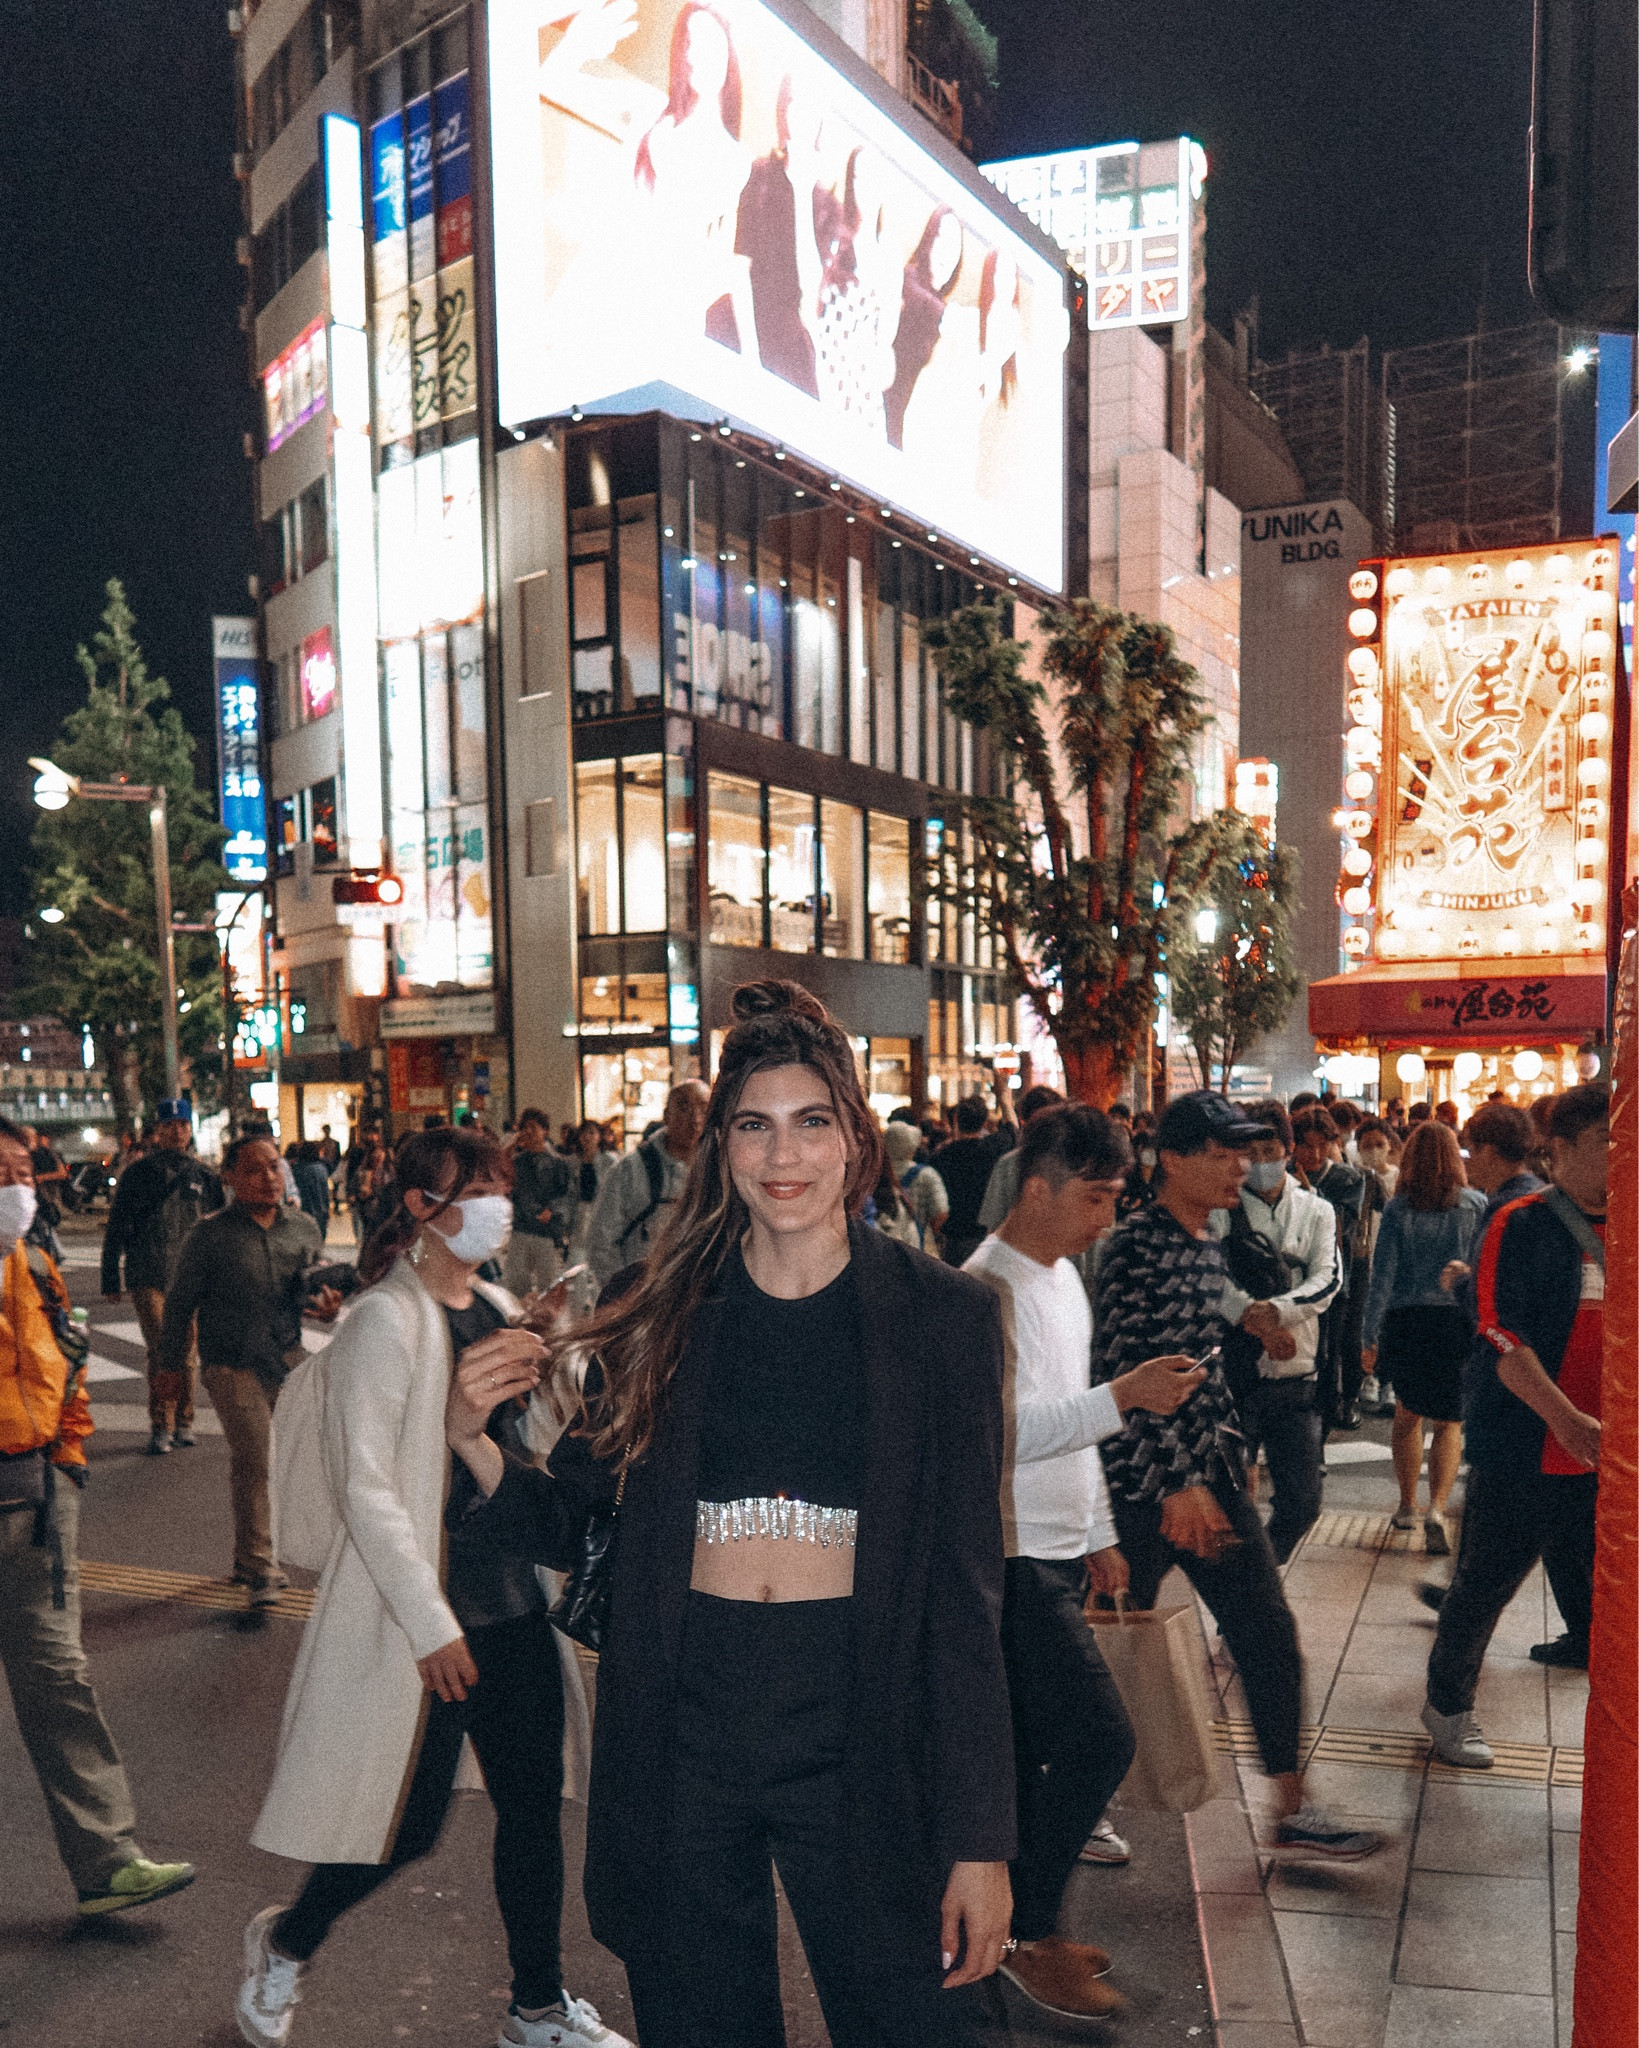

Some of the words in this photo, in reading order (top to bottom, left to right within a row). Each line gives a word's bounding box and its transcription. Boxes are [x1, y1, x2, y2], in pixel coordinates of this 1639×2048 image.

[1440, 599, 1541, 622] YATAIEN
[1431, 887, 1534, 911] SHINJUKU
[1451, 981, 1557, 1027] 屋台苑
